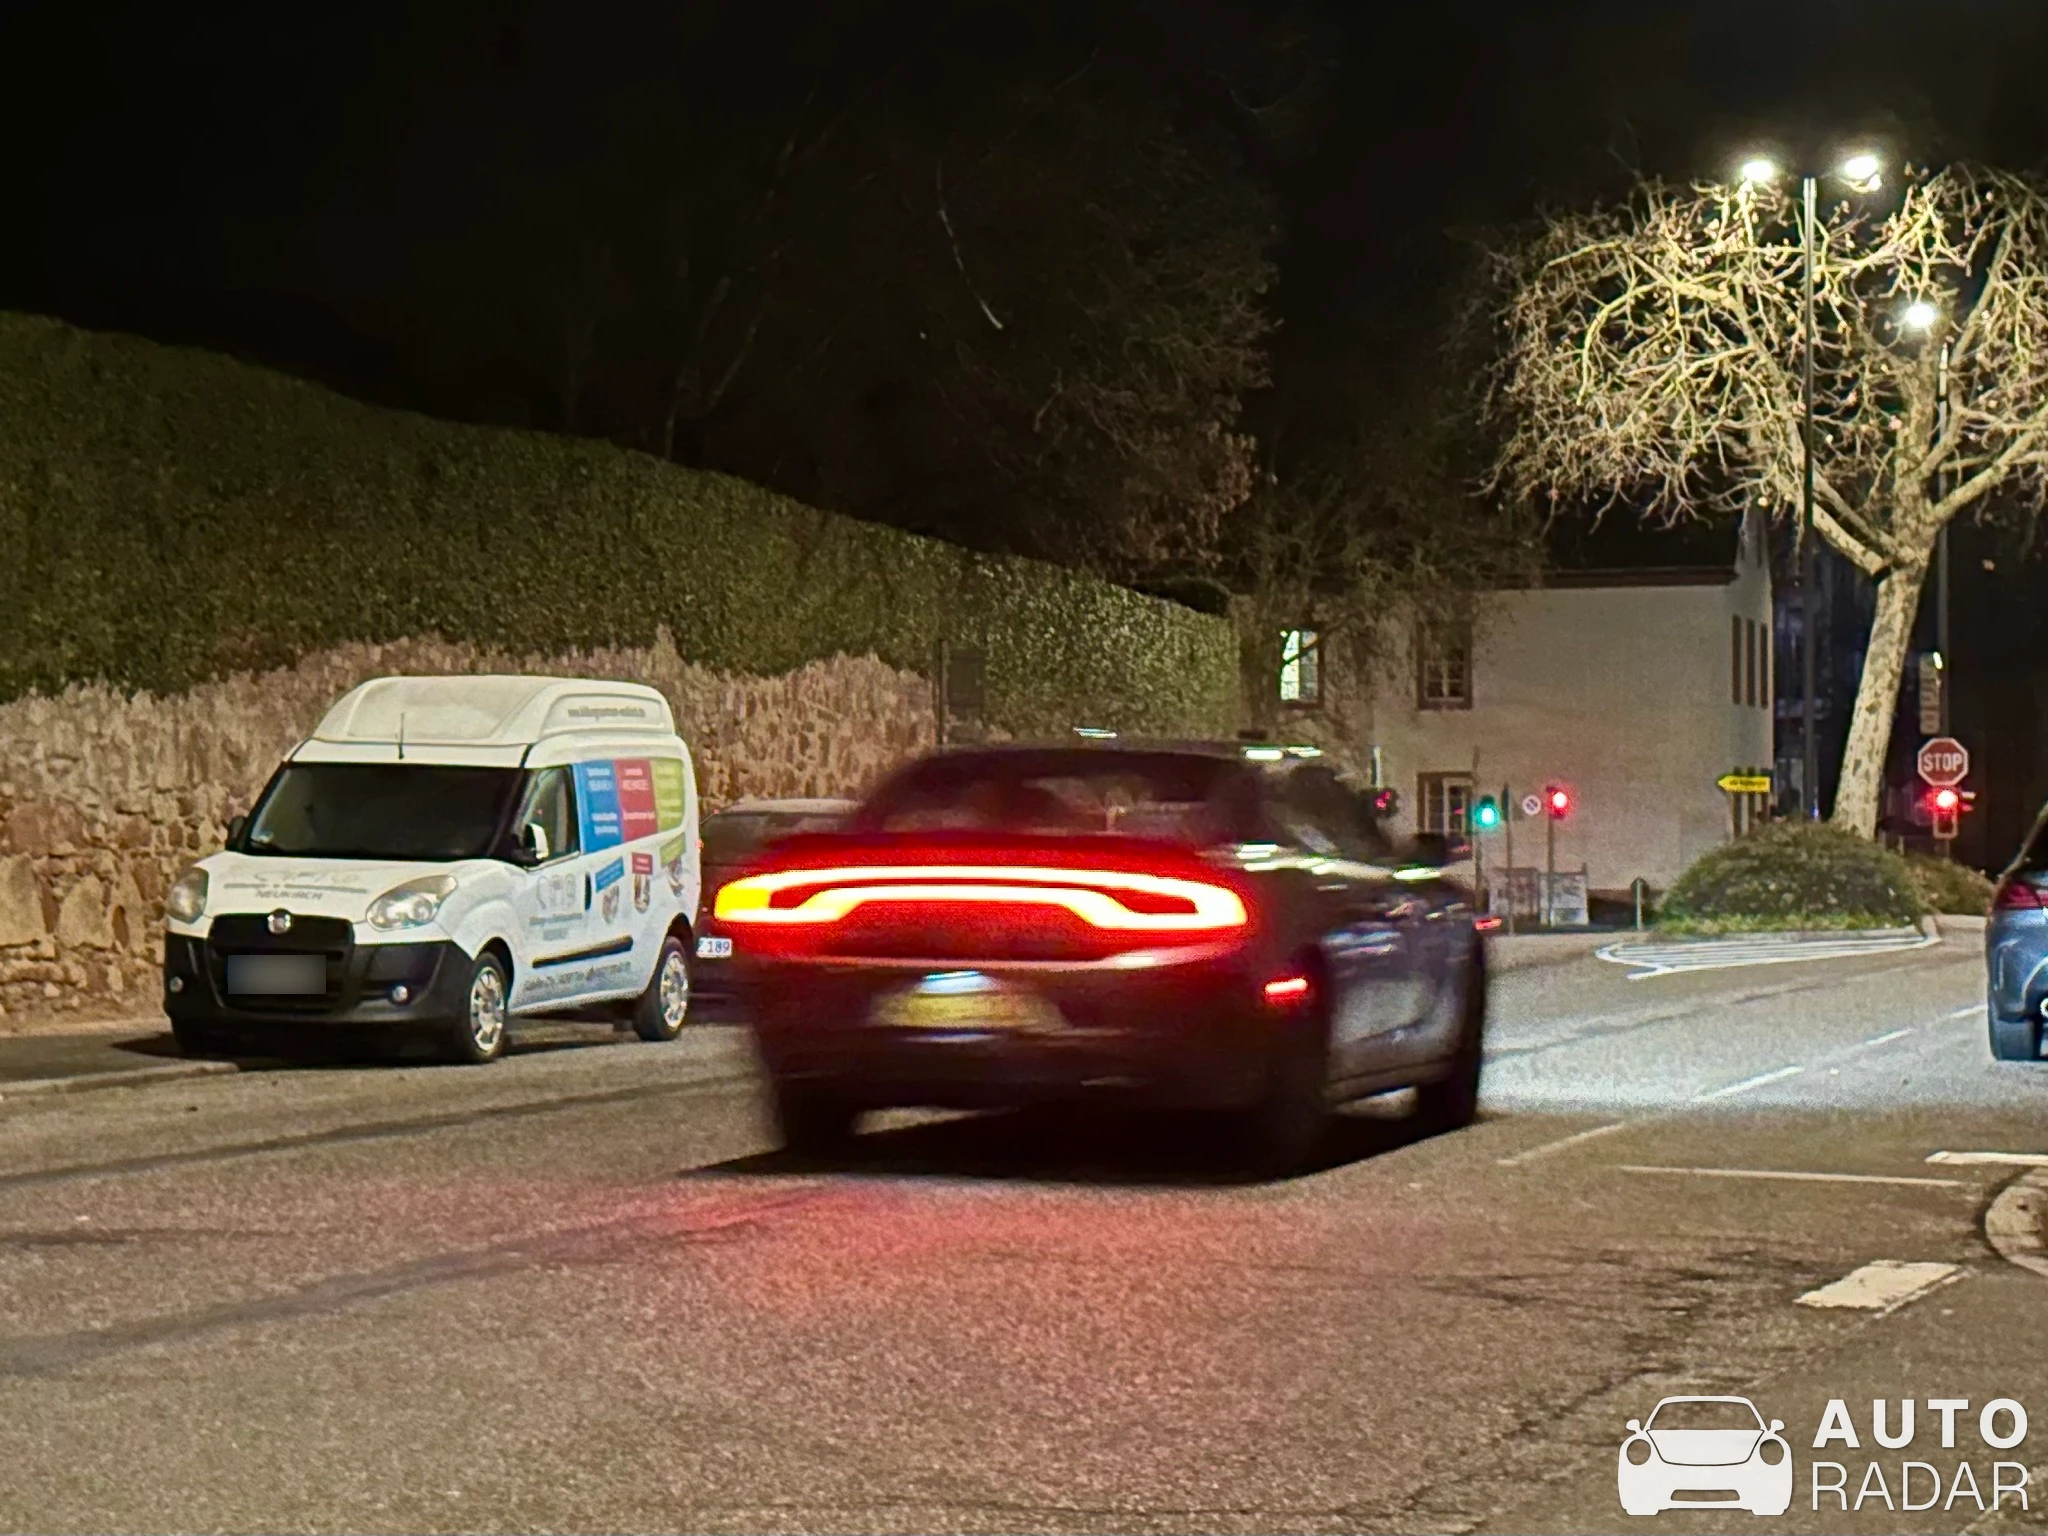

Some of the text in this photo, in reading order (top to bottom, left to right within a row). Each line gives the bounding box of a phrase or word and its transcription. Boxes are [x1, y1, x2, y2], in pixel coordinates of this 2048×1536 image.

[1923, 753, 1962, 772] STOP
[255, 889, 324, 900] NEUKIRCH
[707, 940, 731, 953] 189
